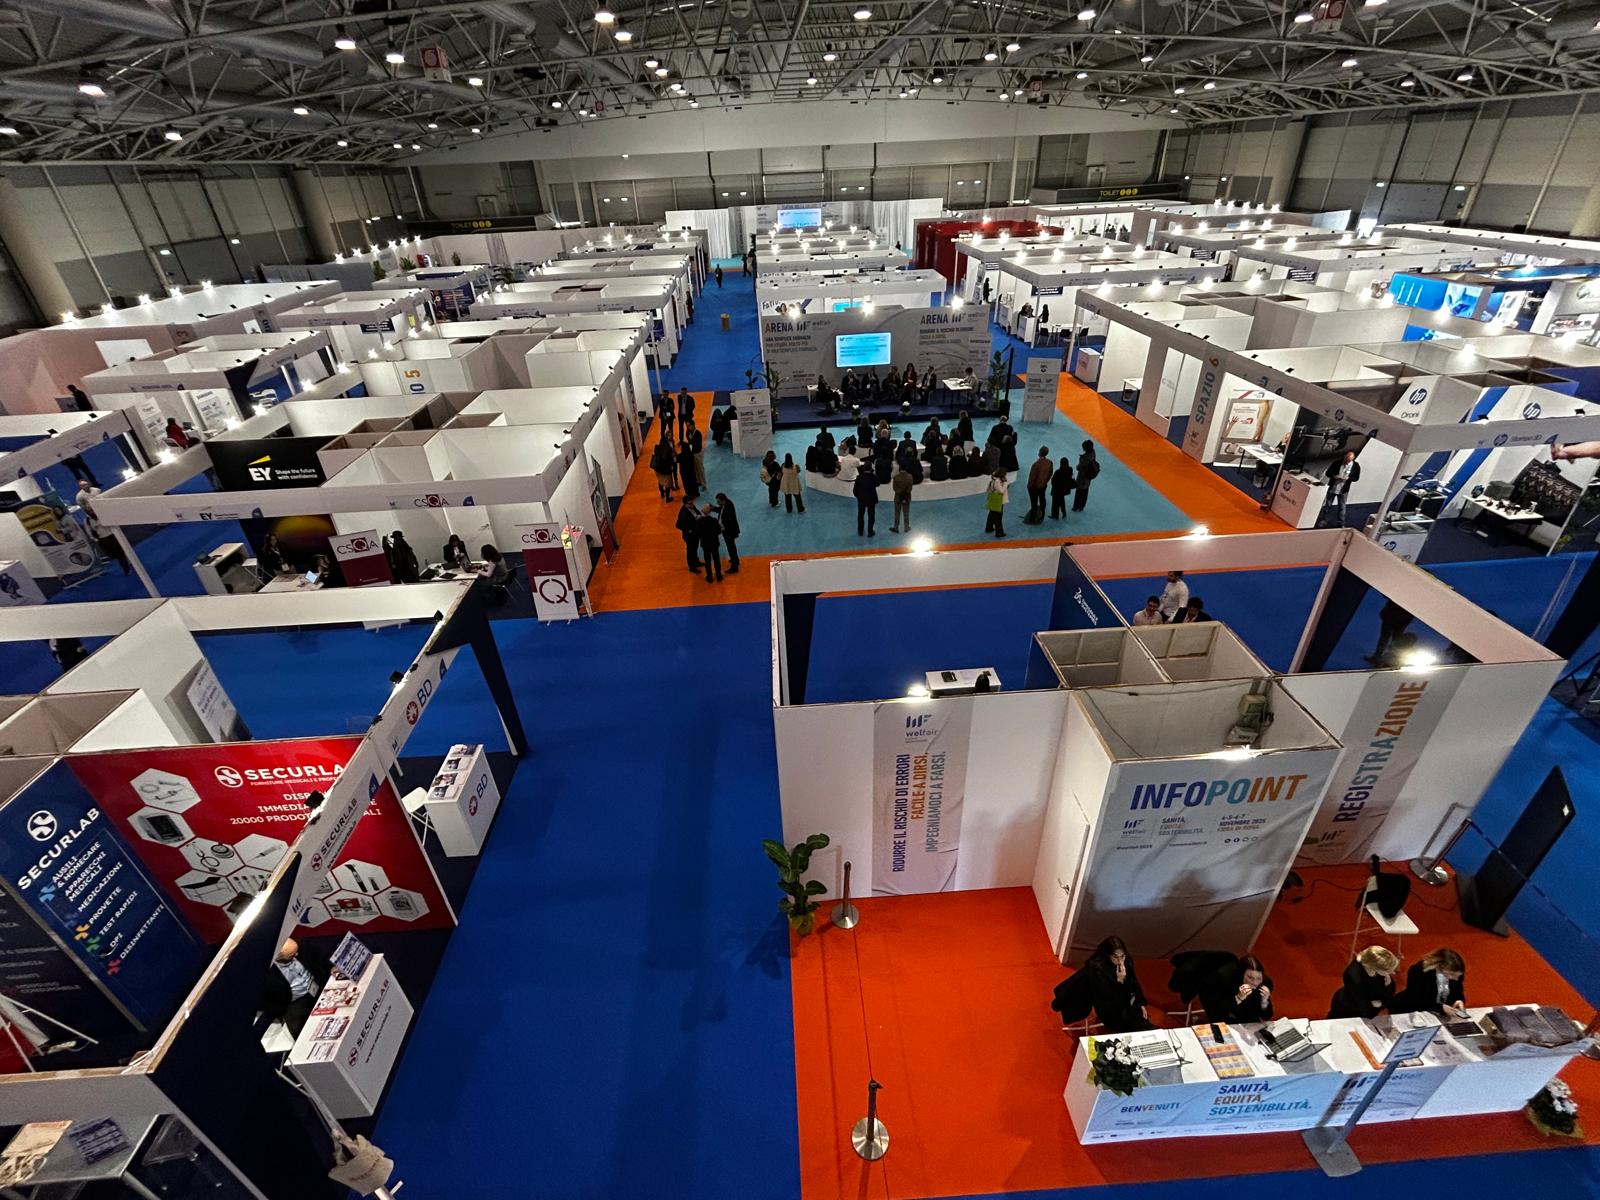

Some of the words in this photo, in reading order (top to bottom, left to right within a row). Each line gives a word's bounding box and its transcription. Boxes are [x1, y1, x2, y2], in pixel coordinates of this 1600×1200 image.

[765, 322, 793, 333] ARENA
[920, 313, 948, 325] ARENA
[1195, 372, 1216, 425] SPAZIO
[1208, 357, 1220, 368] 6
[1409, 387, 1428, 405] hp
[1523, 402, 1541, 420] hp
[248, 467, 272, 481] EY
[414, 494, 449, 508] CSQA
[200, 512, 212, 521] EY
[337, 537, 379, 555] CSQA
[522, 529, 560, 543] CSQA
[539, 578, 569, 604] Q
[417, 679, 433, 707] BD
[906, 729, 938, 737] welfair
[1333, 681, 1429, 823] REGISTRAZIONE
[244, 764, 346, 781] SECURLA
[896, 754, 910, 786] ERRORI
[913, 752, 928, 780] DIRSI,
[930, 751, 946, 781] FARSI.
[283, 792, 311, 801] DISP
[476, 773, 488, 799] BD
[895, 787, 909, 797] DI
[1130, 774, 1309, 811] INFOPOINT
[230, 816, 264, 825] 20000
[266, 813, 313, 823] PRODOT
[258, 803, 313, 813] IMMEDIA
[894, 798, 908, 830] RISCHIO
[911, 791, 926, 820] FACILE
[321, 798, 358, 855] SECURLAB
[893, 831, 907, 839] IL
[925, 792, 943, 853] IMPEGNIAMOCI
[17, 807, 100, 890] SECURLAB
[892, 840, 906, 872] RIDURRE
[52, 856, 79, 883] AUSILI
[57, 880, 65, 888] &
[63, 842, 101, 881] HOMECARE
[64, 851, 107, 897] APPARECCHI
[68, 865, 103, 902] MEDICALI
[77, 861, 124, 913] MEDICAZIONI
[88, 886, 122, 925] PROVETTE
[99, 917, 115, 936] TEST
[115, 890, 139, 918] RAPIDI
[109, 932, 124, 948] DPI
[120, 904, 165, 960] DISINFETTANTI
[356, 979, 389, 1047] SECURLAB
[1120, 1102, 1181, 1113] BENVENUTI
[1209, 1099, 1312, 1116] SOSTENIBILITÀ.
